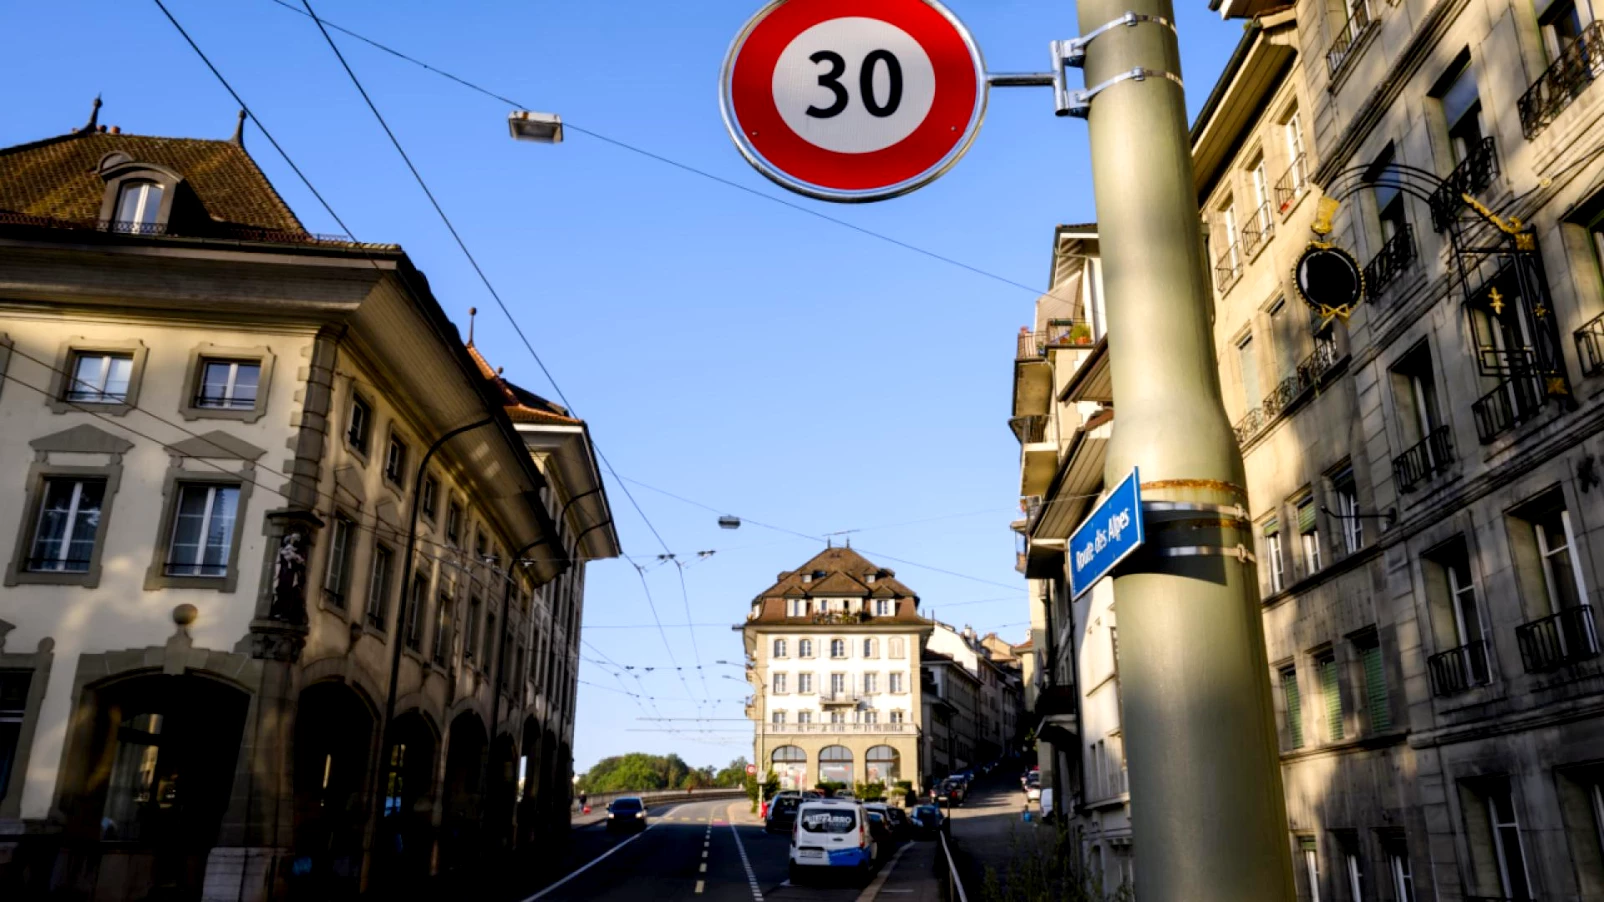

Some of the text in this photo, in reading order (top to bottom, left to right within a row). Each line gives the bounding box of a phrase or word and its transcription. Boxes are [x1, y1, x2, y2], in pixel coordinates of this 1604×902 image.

[805, 49, 903, 119] 30
[1076, 541, 1094, 572] Route
[1108, 507, 1130, 542] Alpes
